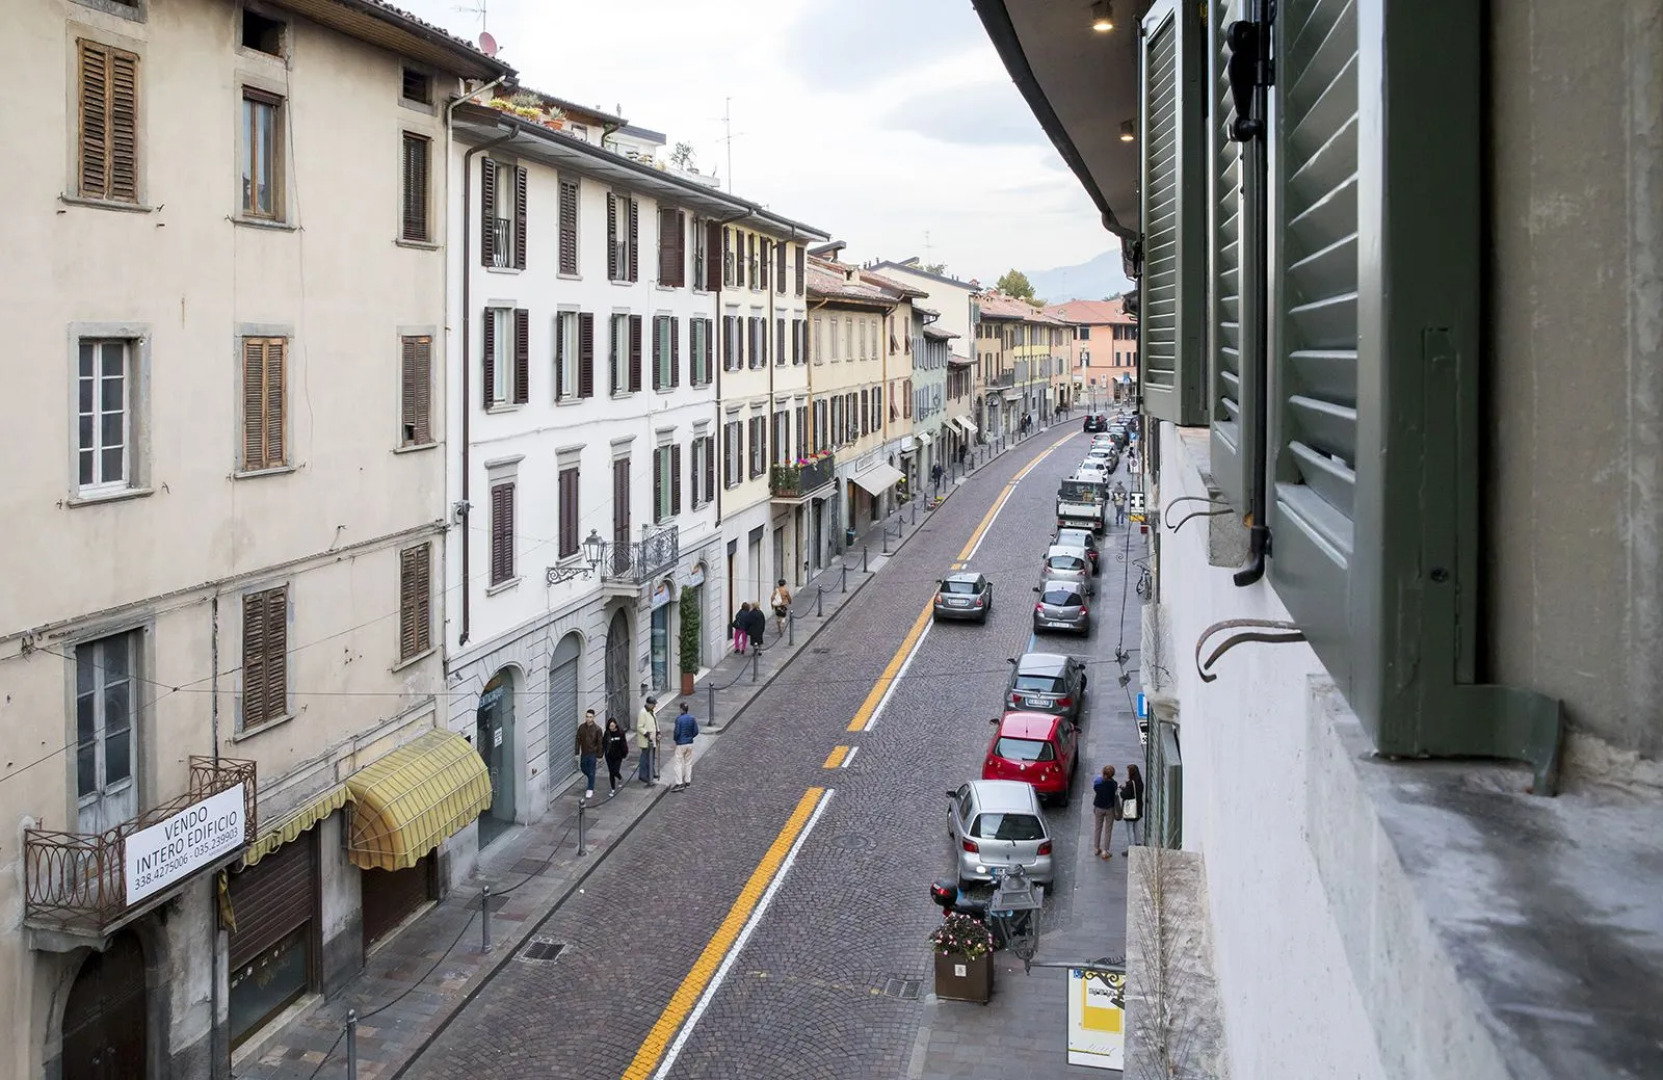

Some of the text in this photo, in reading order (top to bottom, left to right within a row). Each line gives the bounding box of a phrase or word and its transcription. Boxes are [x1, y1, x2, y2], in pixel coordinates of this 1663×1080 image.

[136, 838, 184, 874] INTERO
[188, 811, 237, 848] EDIFICIO
[164, 806, 208, 841] VENDO
[134, 852, 188, 891] 338.4275006
[195, 826, 238, 859] 035.239903
